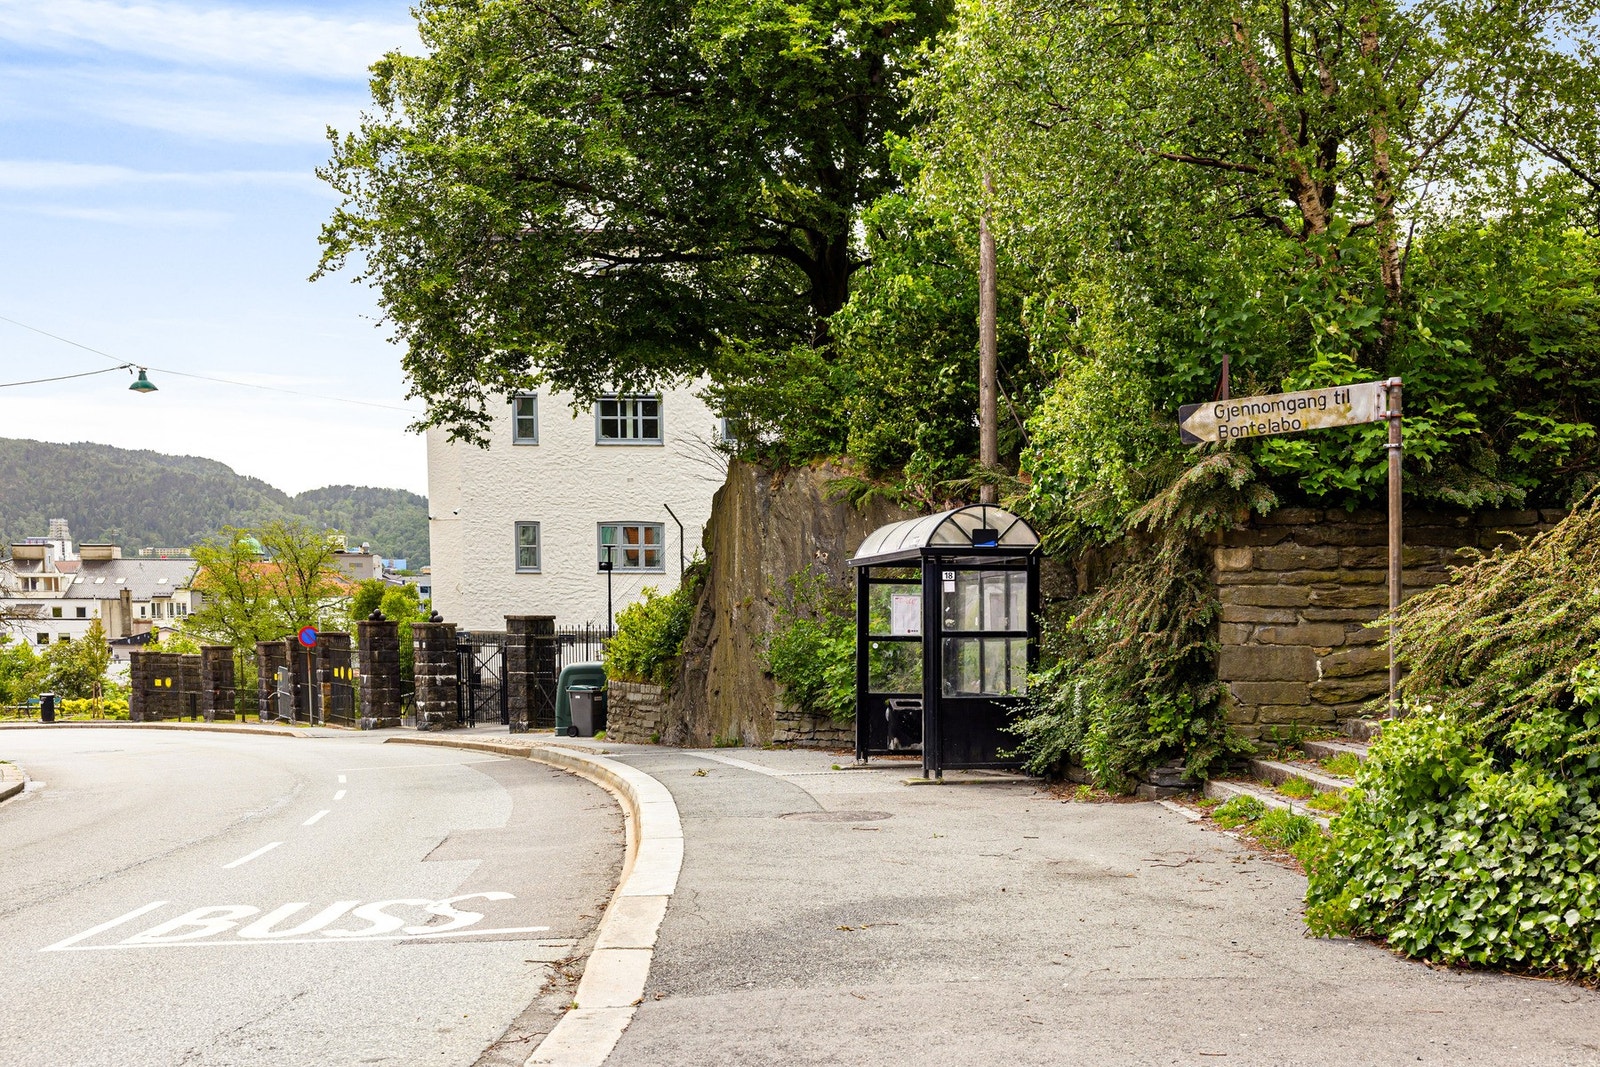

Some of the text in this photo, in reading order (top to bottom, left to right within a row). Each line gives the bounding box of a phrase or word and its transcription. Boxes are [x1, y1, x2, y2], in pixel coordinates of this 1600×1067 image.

[1213, 388, 1351, 423] Gjennomgang til
[1218, 416, 1302, 440] Bontelabo
[944, 571, 954, 580] 18
[119, 891, 516, 944] BUSS
